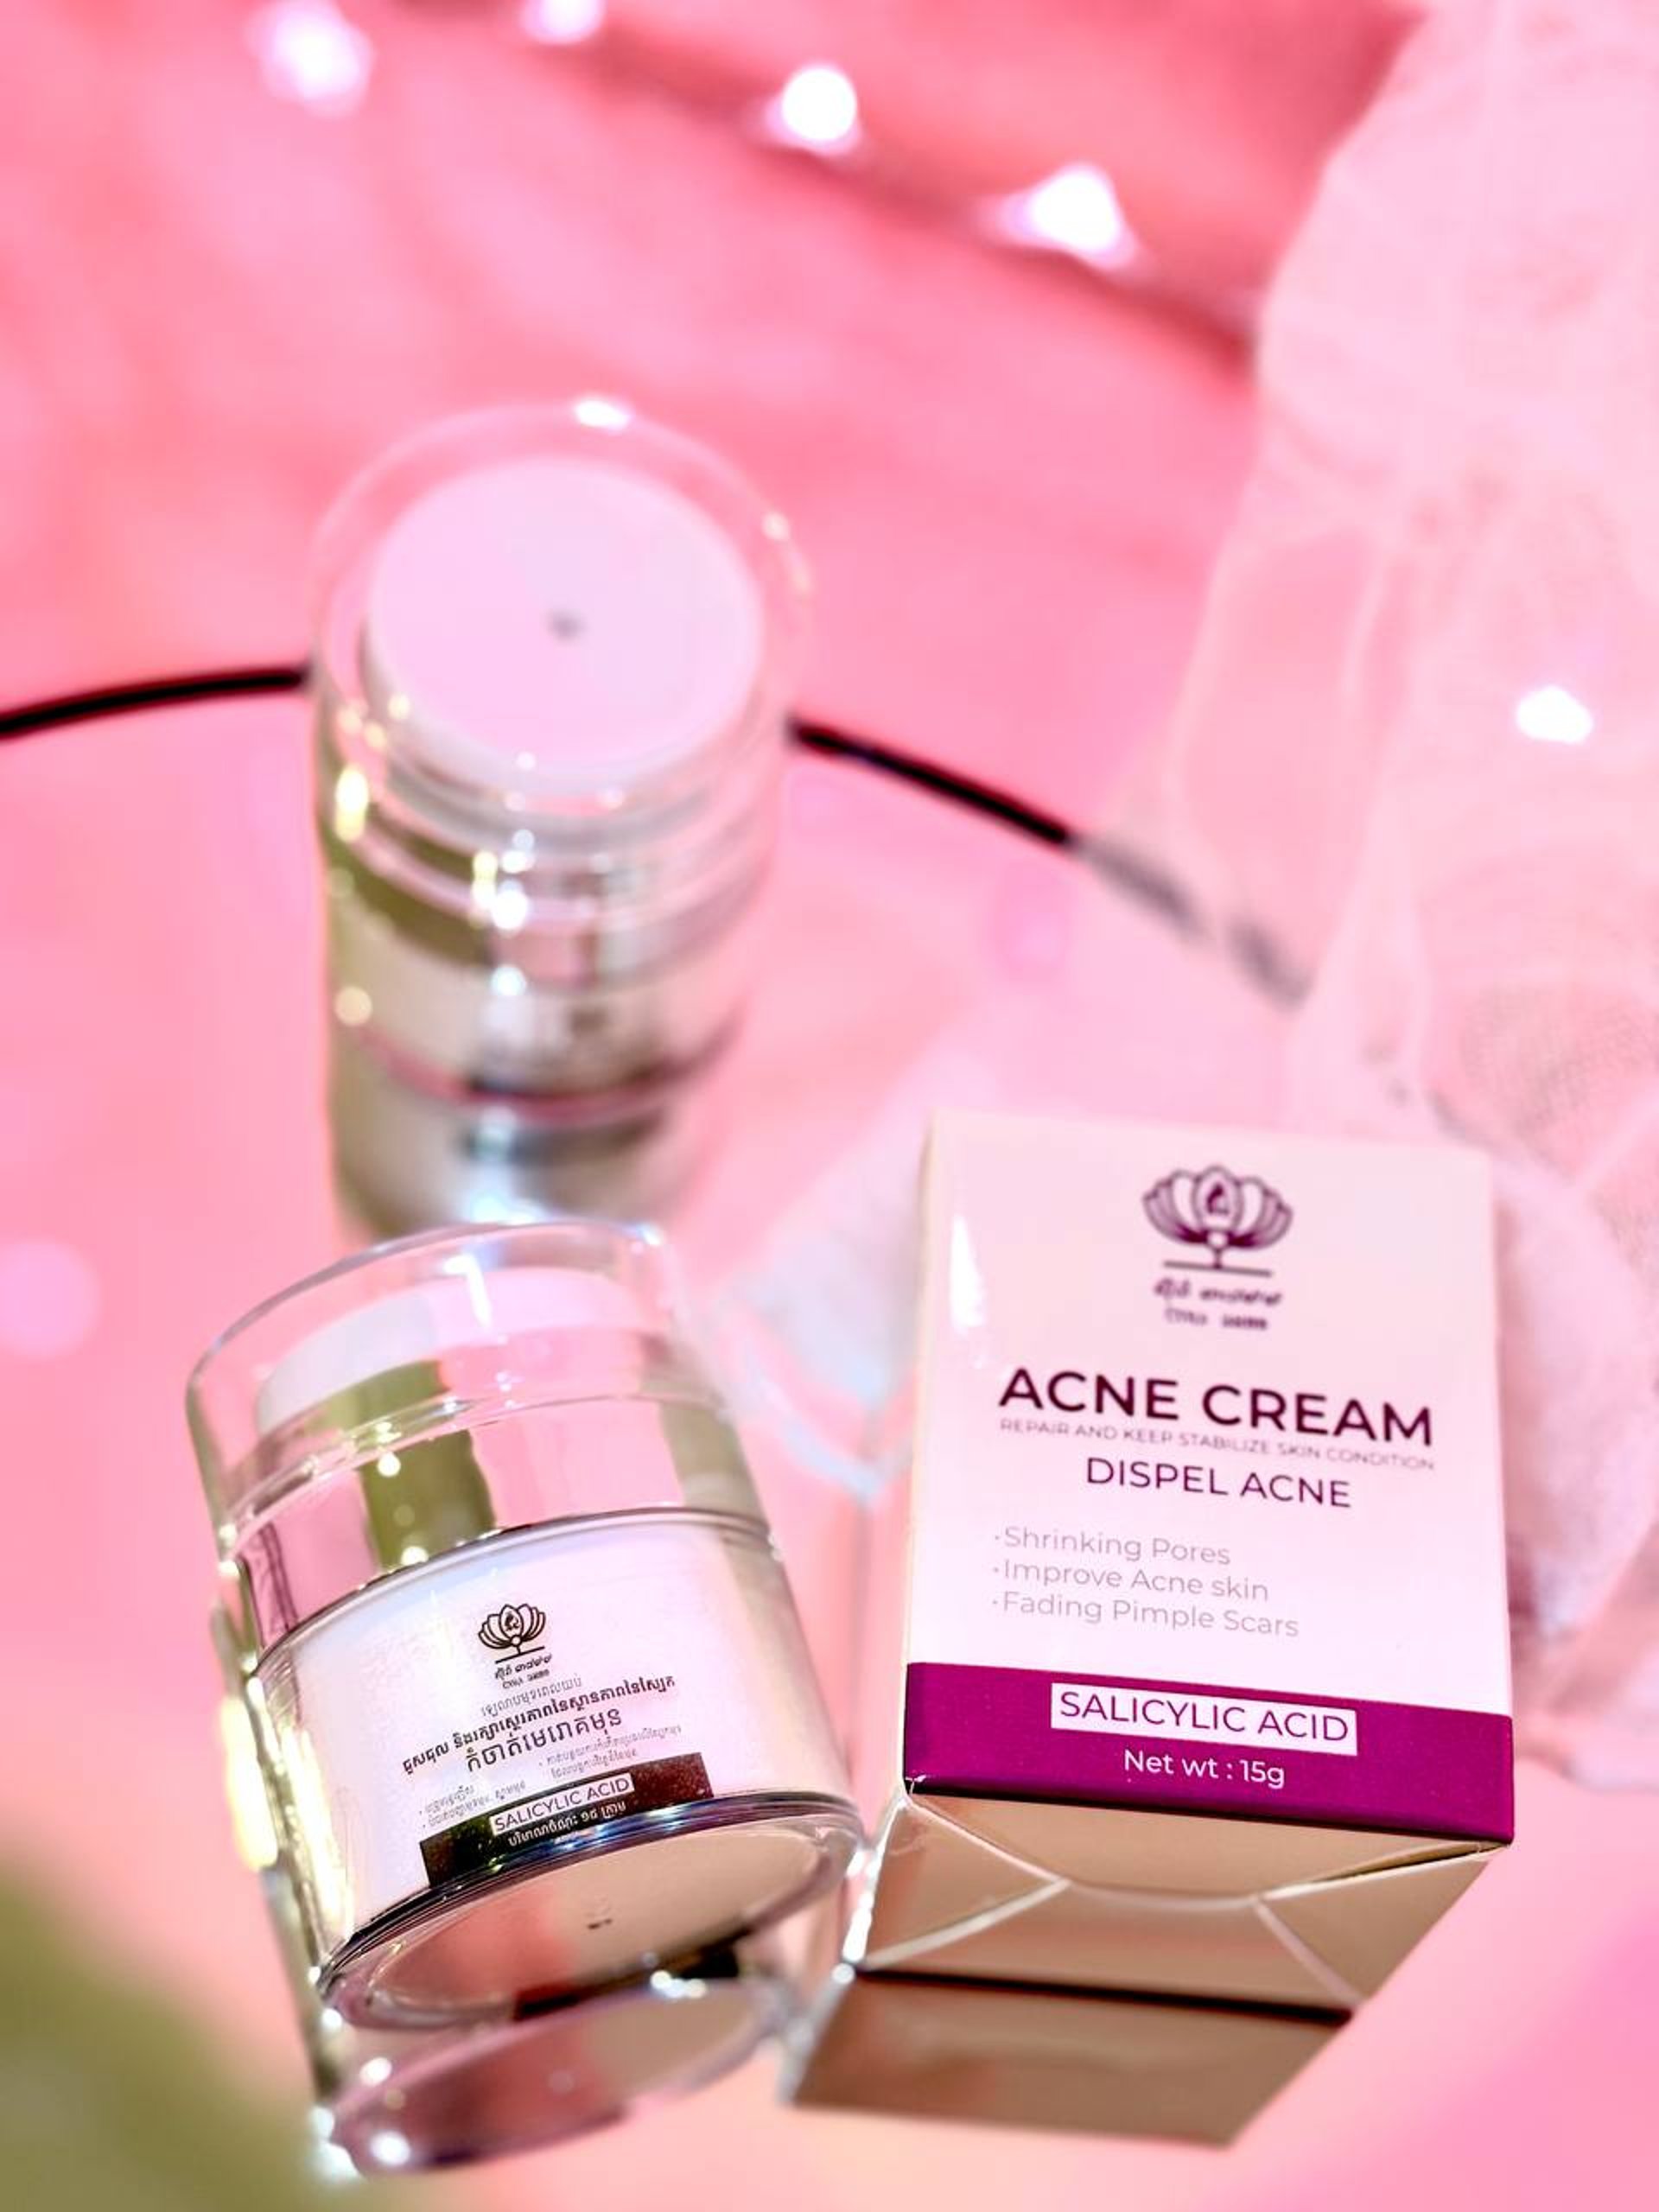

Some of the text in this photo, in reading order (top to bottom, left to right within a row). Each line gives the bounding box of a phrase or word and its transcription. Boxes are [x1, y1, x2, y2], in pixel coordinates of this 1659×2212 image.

[999, 1368, 1432, 1447] ACNE CREAM
[1000, 1418, 1434, 1471] REPAIR AND KEEP STABILIZE SKIN CONDITION
[1087, 1457, 1351, 1508] DISPEL ACNE
[1004, 1526, 1231, 1566] Shrinking Pores
[1004, 1559, 1269, 1601] Improve Acne skin
[1003, 1591, 1300, 1637] Fading Pimple Scars
[1060, 1691, 1349, 1742] SALICYLIC ACID
[1124, 1750, 1173, 1774] Net
[1182, 1758, 1218, 1780] wt
[1239, 1758, 1285, 1789] 15g
[494, 1792, 582, 1832] SALICYLIC
[586, 1777, 630, 1802] ACID
